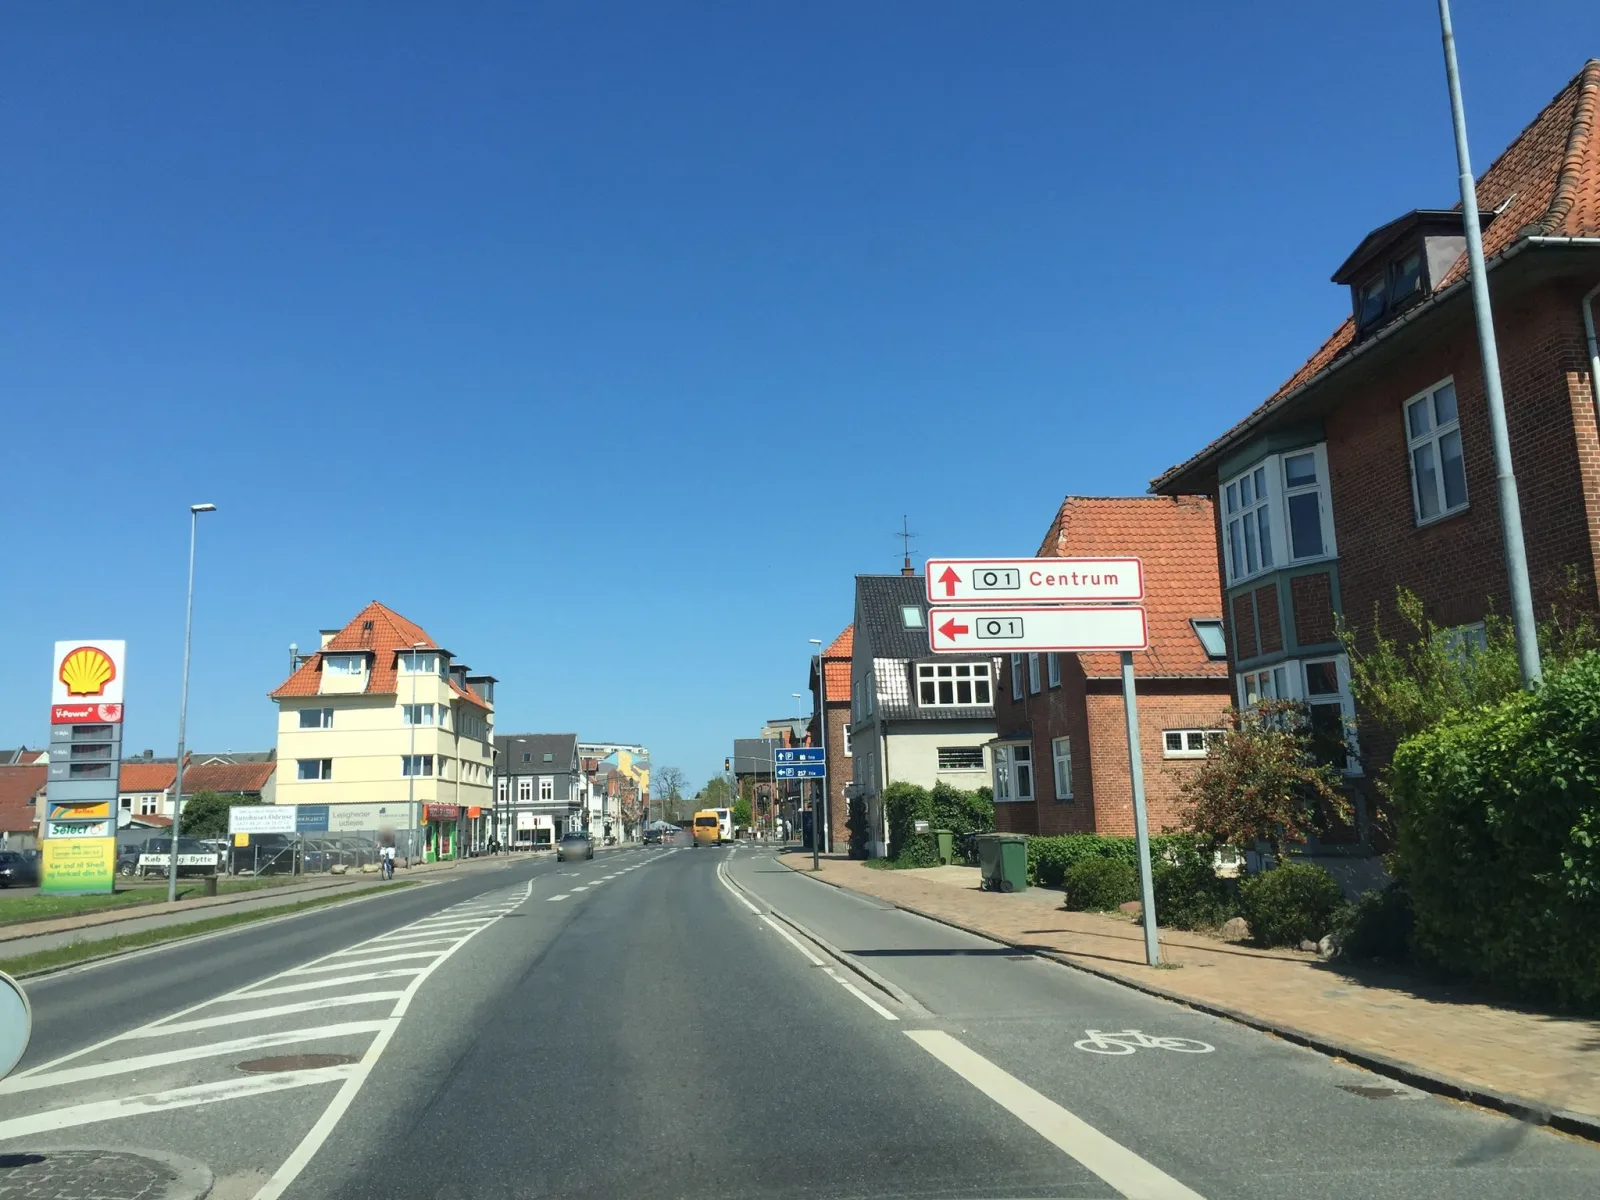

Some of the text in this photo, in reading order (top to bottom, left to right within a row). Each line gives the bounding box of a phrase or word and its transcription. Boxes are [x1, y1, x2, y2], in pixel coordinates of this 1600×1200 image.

[1029, 571, 1119, 586] Centrum
[56, 710, 89, 718] V-Power
[52, 824, 88, 835] Select
[190, 855, 212, 864] Bytte
